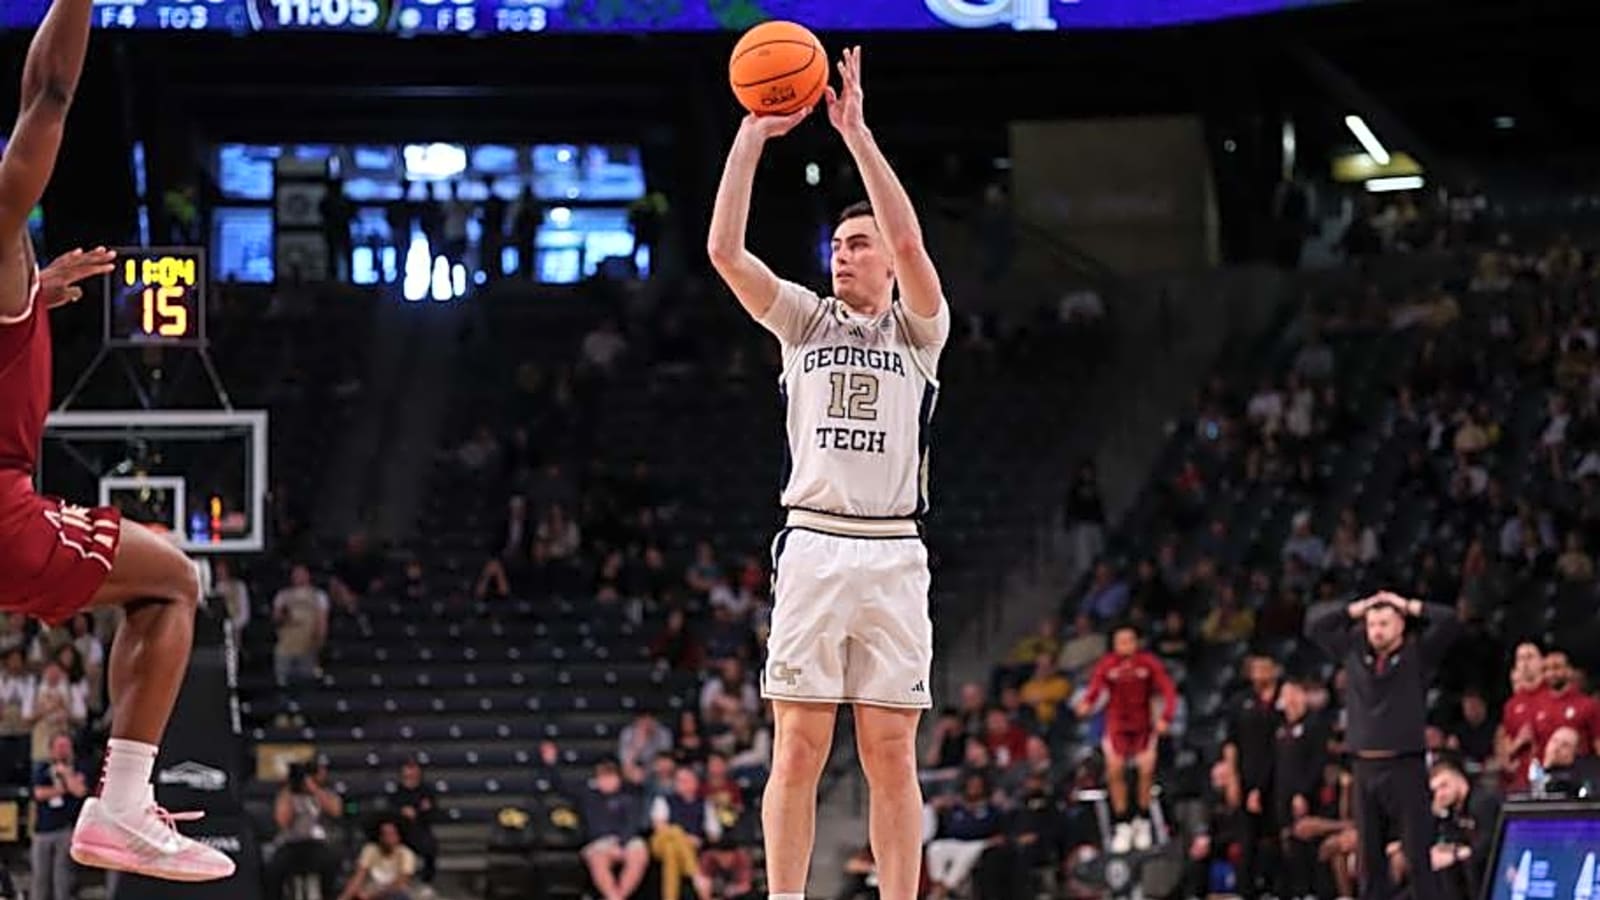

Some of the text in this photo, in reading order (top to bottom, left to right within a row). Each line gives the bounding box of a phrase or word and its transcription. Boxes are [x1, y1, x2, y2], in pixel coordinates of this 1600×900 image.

[270, 0, 379, 26] 11:05
[125, 256, 195, 286] 11:04
[143, 286, 187, 336] 15
[803, 345, 905, 377] GEORGIA
[827, 371, 879, 421] 12
[816, 427, 886, 454] TECH
